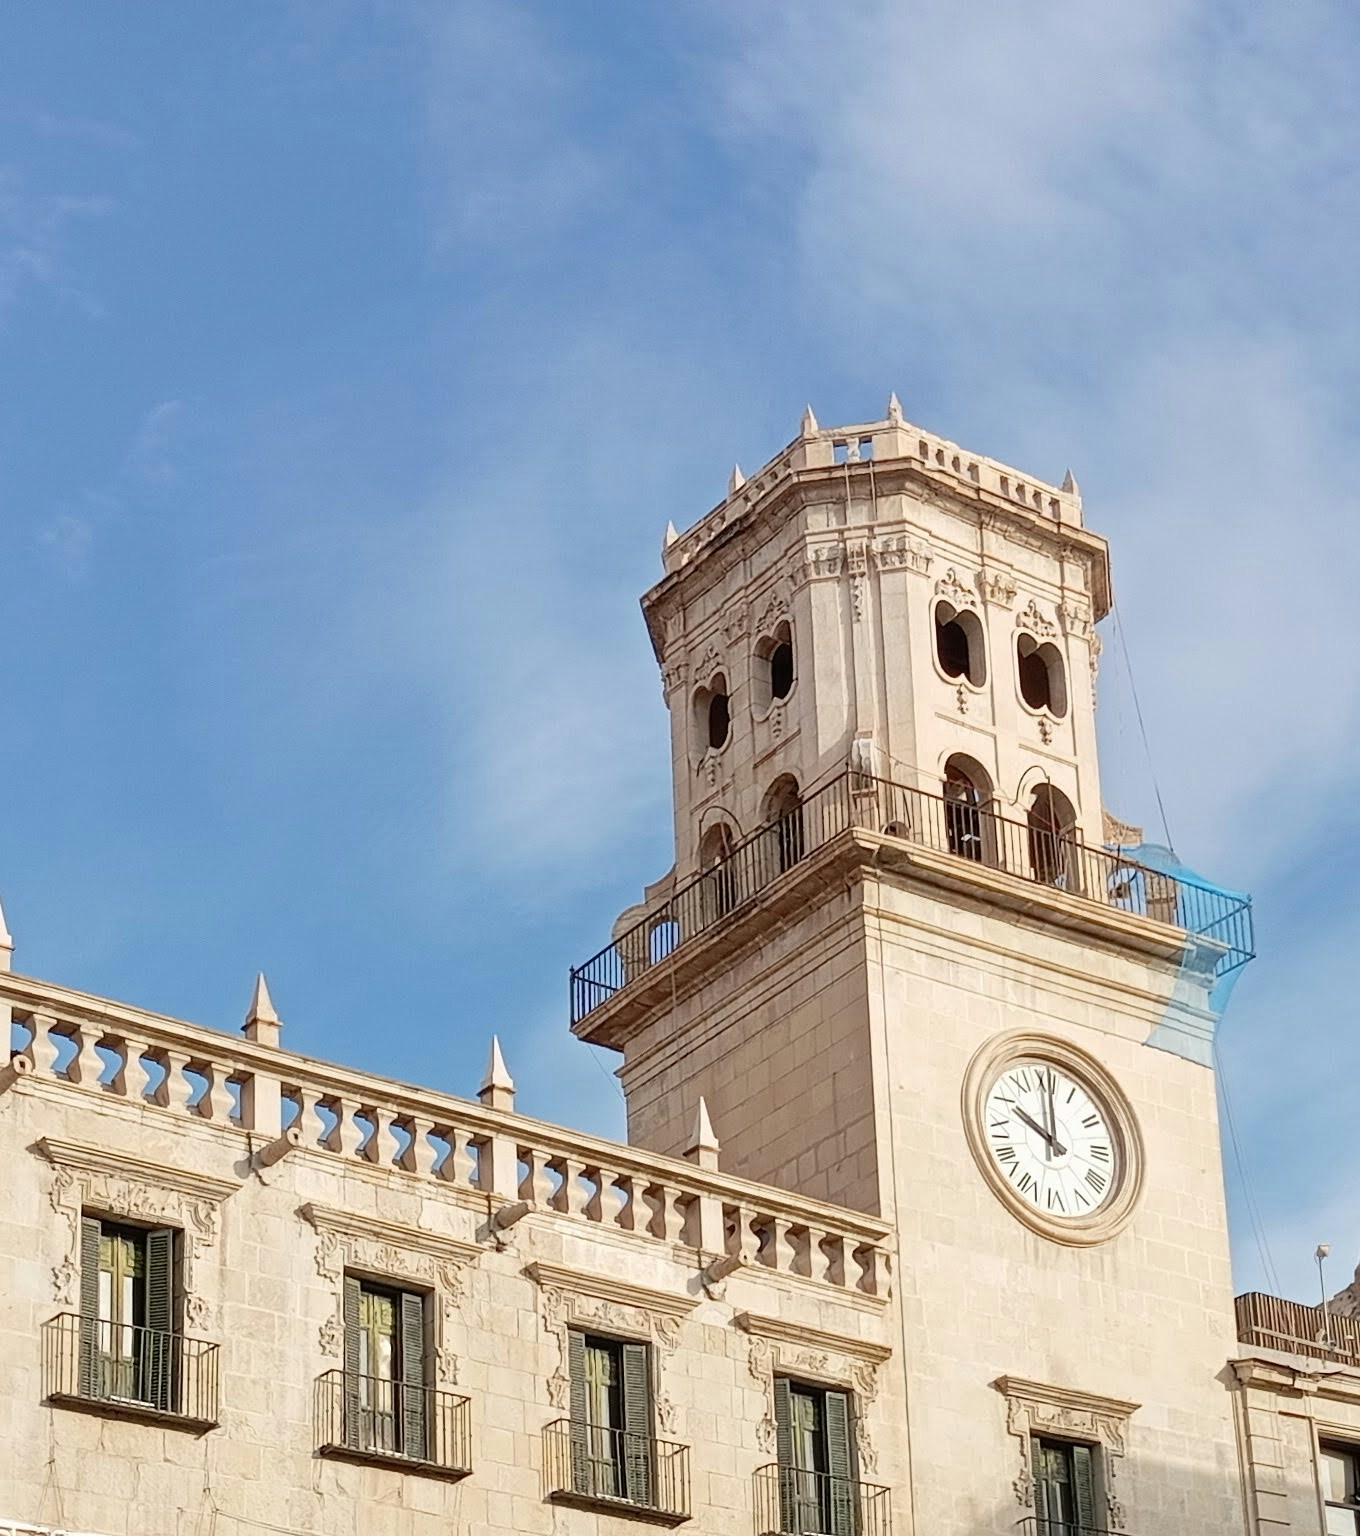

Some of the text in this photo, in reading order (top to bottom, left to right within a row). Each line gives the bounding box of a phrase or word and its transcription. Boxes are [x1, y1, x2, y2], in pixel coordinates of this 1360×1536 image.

[1008, 1069, 1032, 1097] XI
[1034, 1068, 1056, 1095] XI
[993, 1084, 1016, 1115] X
[1066, 1086, 1076, 1104] I
[990, 1113, 1010, 1139] IX
[1081, 1113, 1100, 1129] II
[995, 1146, 1020, 1178] VIII
[1089, 1144, 1110, 1163] III
[1016, 1172, 1038, 1203] VII
[1084, 1168, 1107, 1195] IIII
[1047, 1187, 1066, 1213] VI
[1073, 1187, 1091, 1211] V
